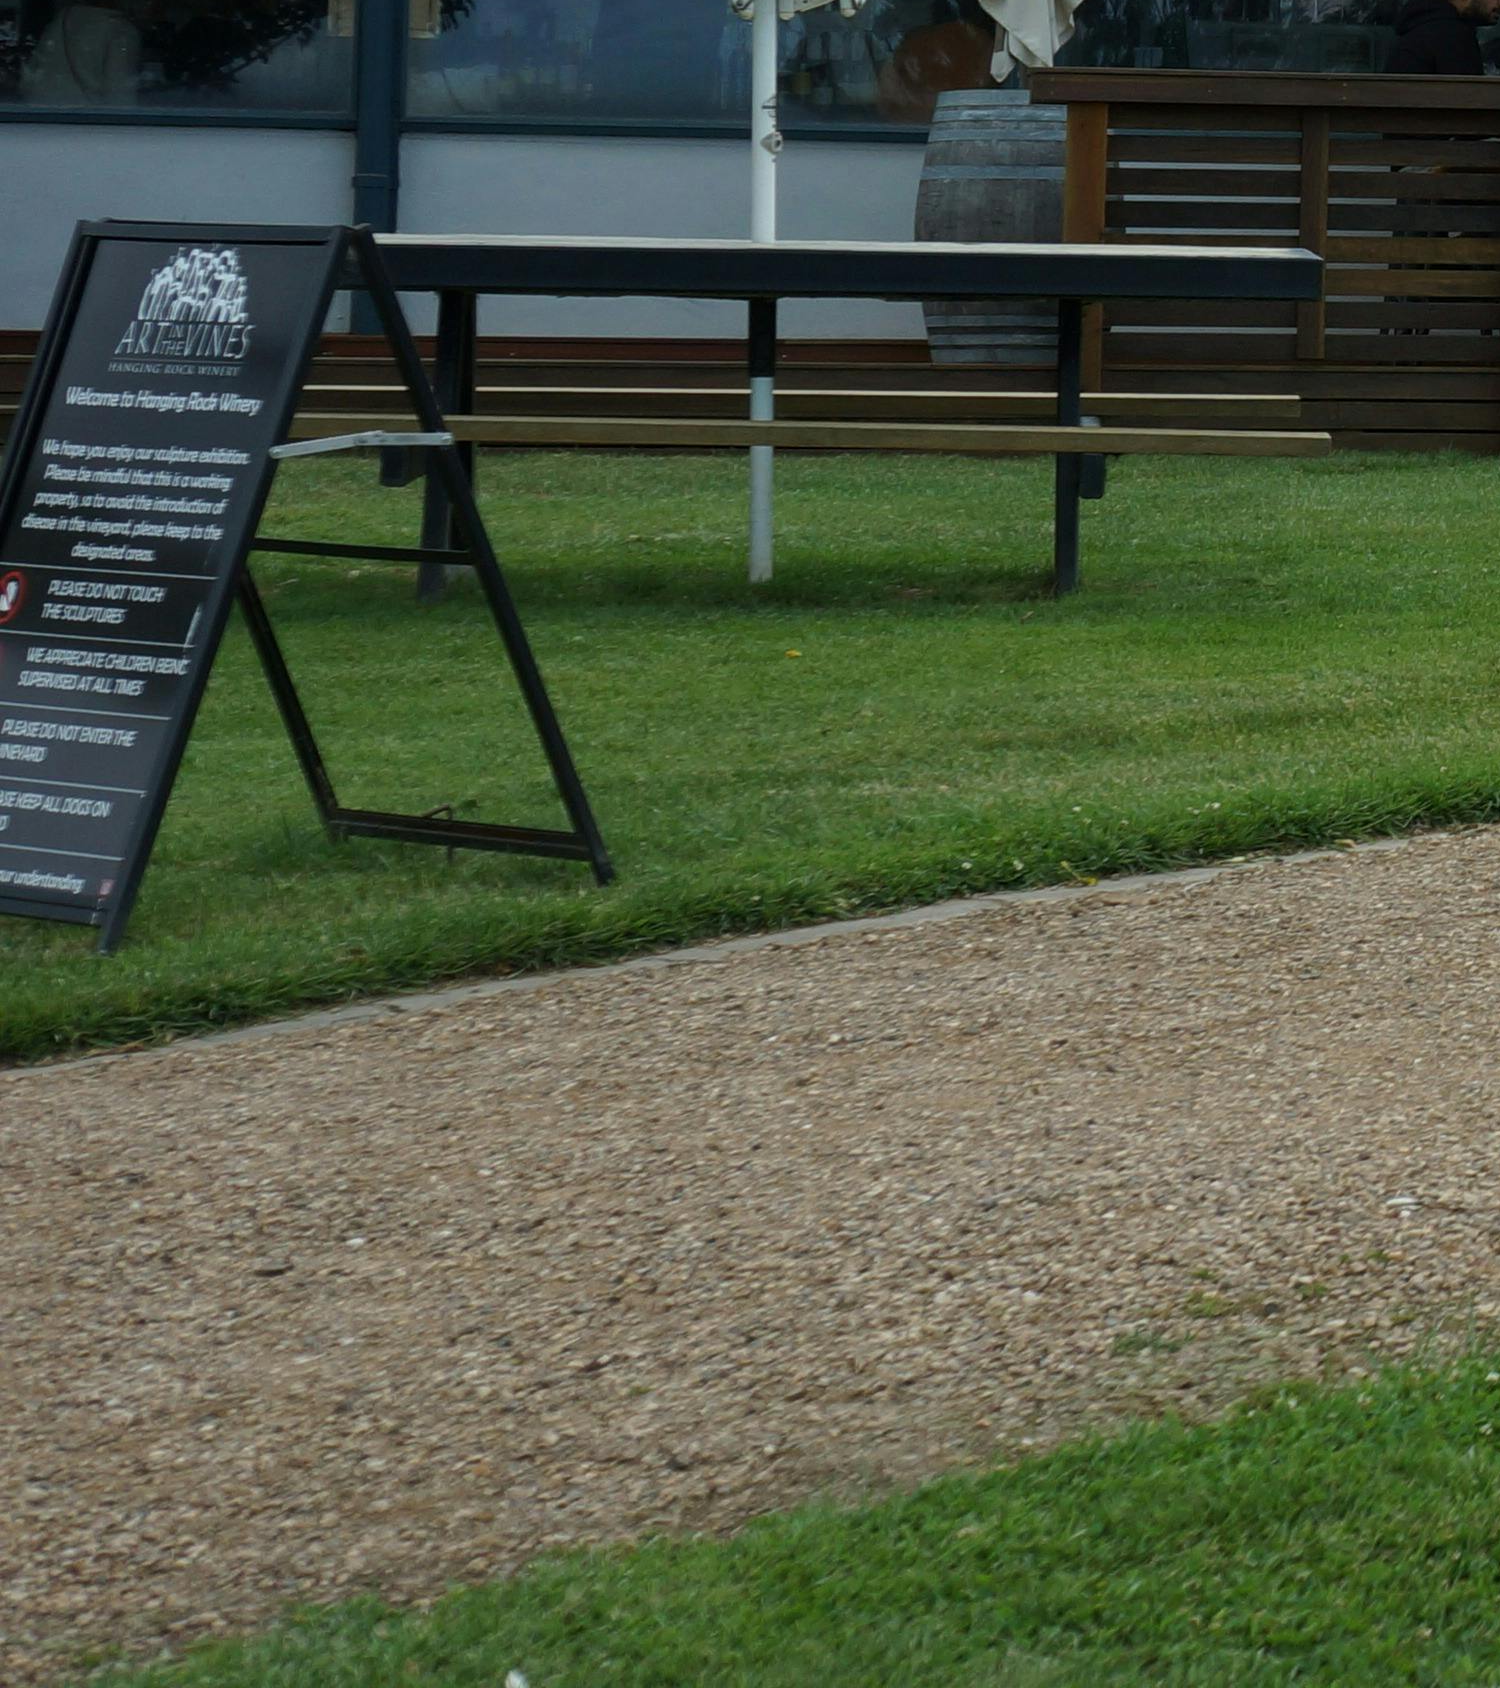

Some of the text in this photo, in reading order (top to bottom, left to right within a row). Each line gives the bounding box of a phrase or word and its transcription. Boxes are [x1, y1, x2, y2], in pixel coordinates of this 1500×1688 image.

[114, 320, 256, 359] ART IN THE VINES
[107, 362, 242, 377] HANGING ROCK WINERY
[65, 386, 264, 417] Welcome to Hanging Rock Winery
[42, 438, 60, 455] We
[60, 440, 86, 459] hope
[85, 445, 107, 460] you
[107, 444, 135, 463] enjoy
[134, 448, 153, 460] our
[153, 446, 199, 464] sculpture
[43, 463, 234, 492] Please be mindful that this is a working
[80, 495, 93, 507] so
[92, 493, 106, 508] to
[105, 494, 135, 510] avoid
[134, 495, 153, 511] the
[152, 496, 212, 514] introduction
[211, 498, 229, 515] of
[21, 512, 58, 530] disease
[57, 515, 68, 530] in
[68, 515, 87, 532] the
[130, 519, 164, 538] please
[163, 521, 192, 541] keep
[190, 524, 203, 539] to
[203, 523, 225, 541] the
[71, 541, 125, 561] designated
[48, 579, 168, 603] PLEASE DO NOT TOUCH
[41, 602, 128, 624] THE SCULPTURES
[26, 646, 192, 676] WE APPRECIATE CHILDREN BEING
[17, 670, 148, 697] SUPERVISED AT ALL TIMES
[1, 718, 138, 748] PLEASE DO NOT ENTER THE
[0, 742, 48, 763] INEYARD
[15, 791, 44, 811] KEEP
[40, 795, 64, 813] ALL
[61, 797, 96, 816] DOGS
[91, 800, 113, 819] ON
